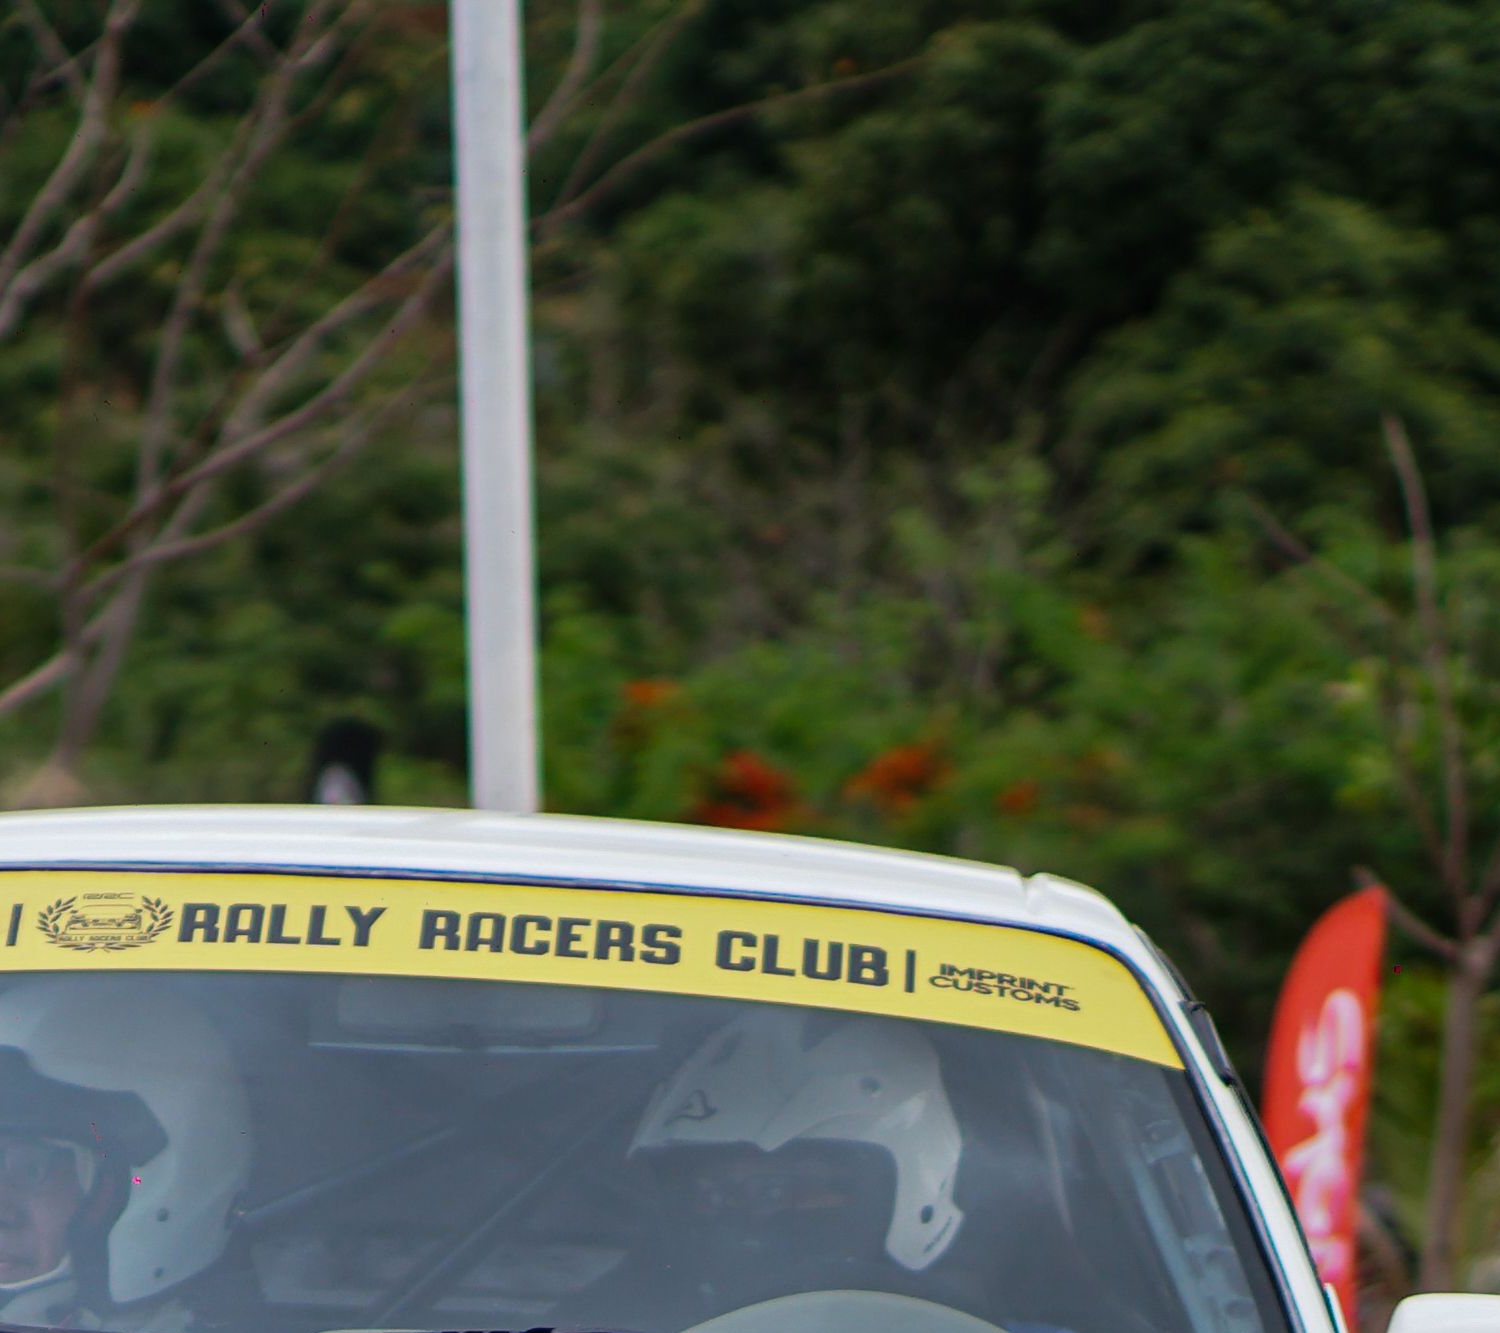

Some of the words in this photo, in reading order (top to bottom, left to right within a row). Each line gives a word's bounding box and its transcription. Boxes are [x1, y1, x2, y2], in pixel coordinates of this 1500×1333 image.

[178, 903, 387, 947] RALLY
[419, 909, 683, 965] RACERS
[715, 930, 889, 987] CLUB
[929, 975, 1081, 1012] CUSTOMS
[940, 963, 1076, 996] IMPRINT
